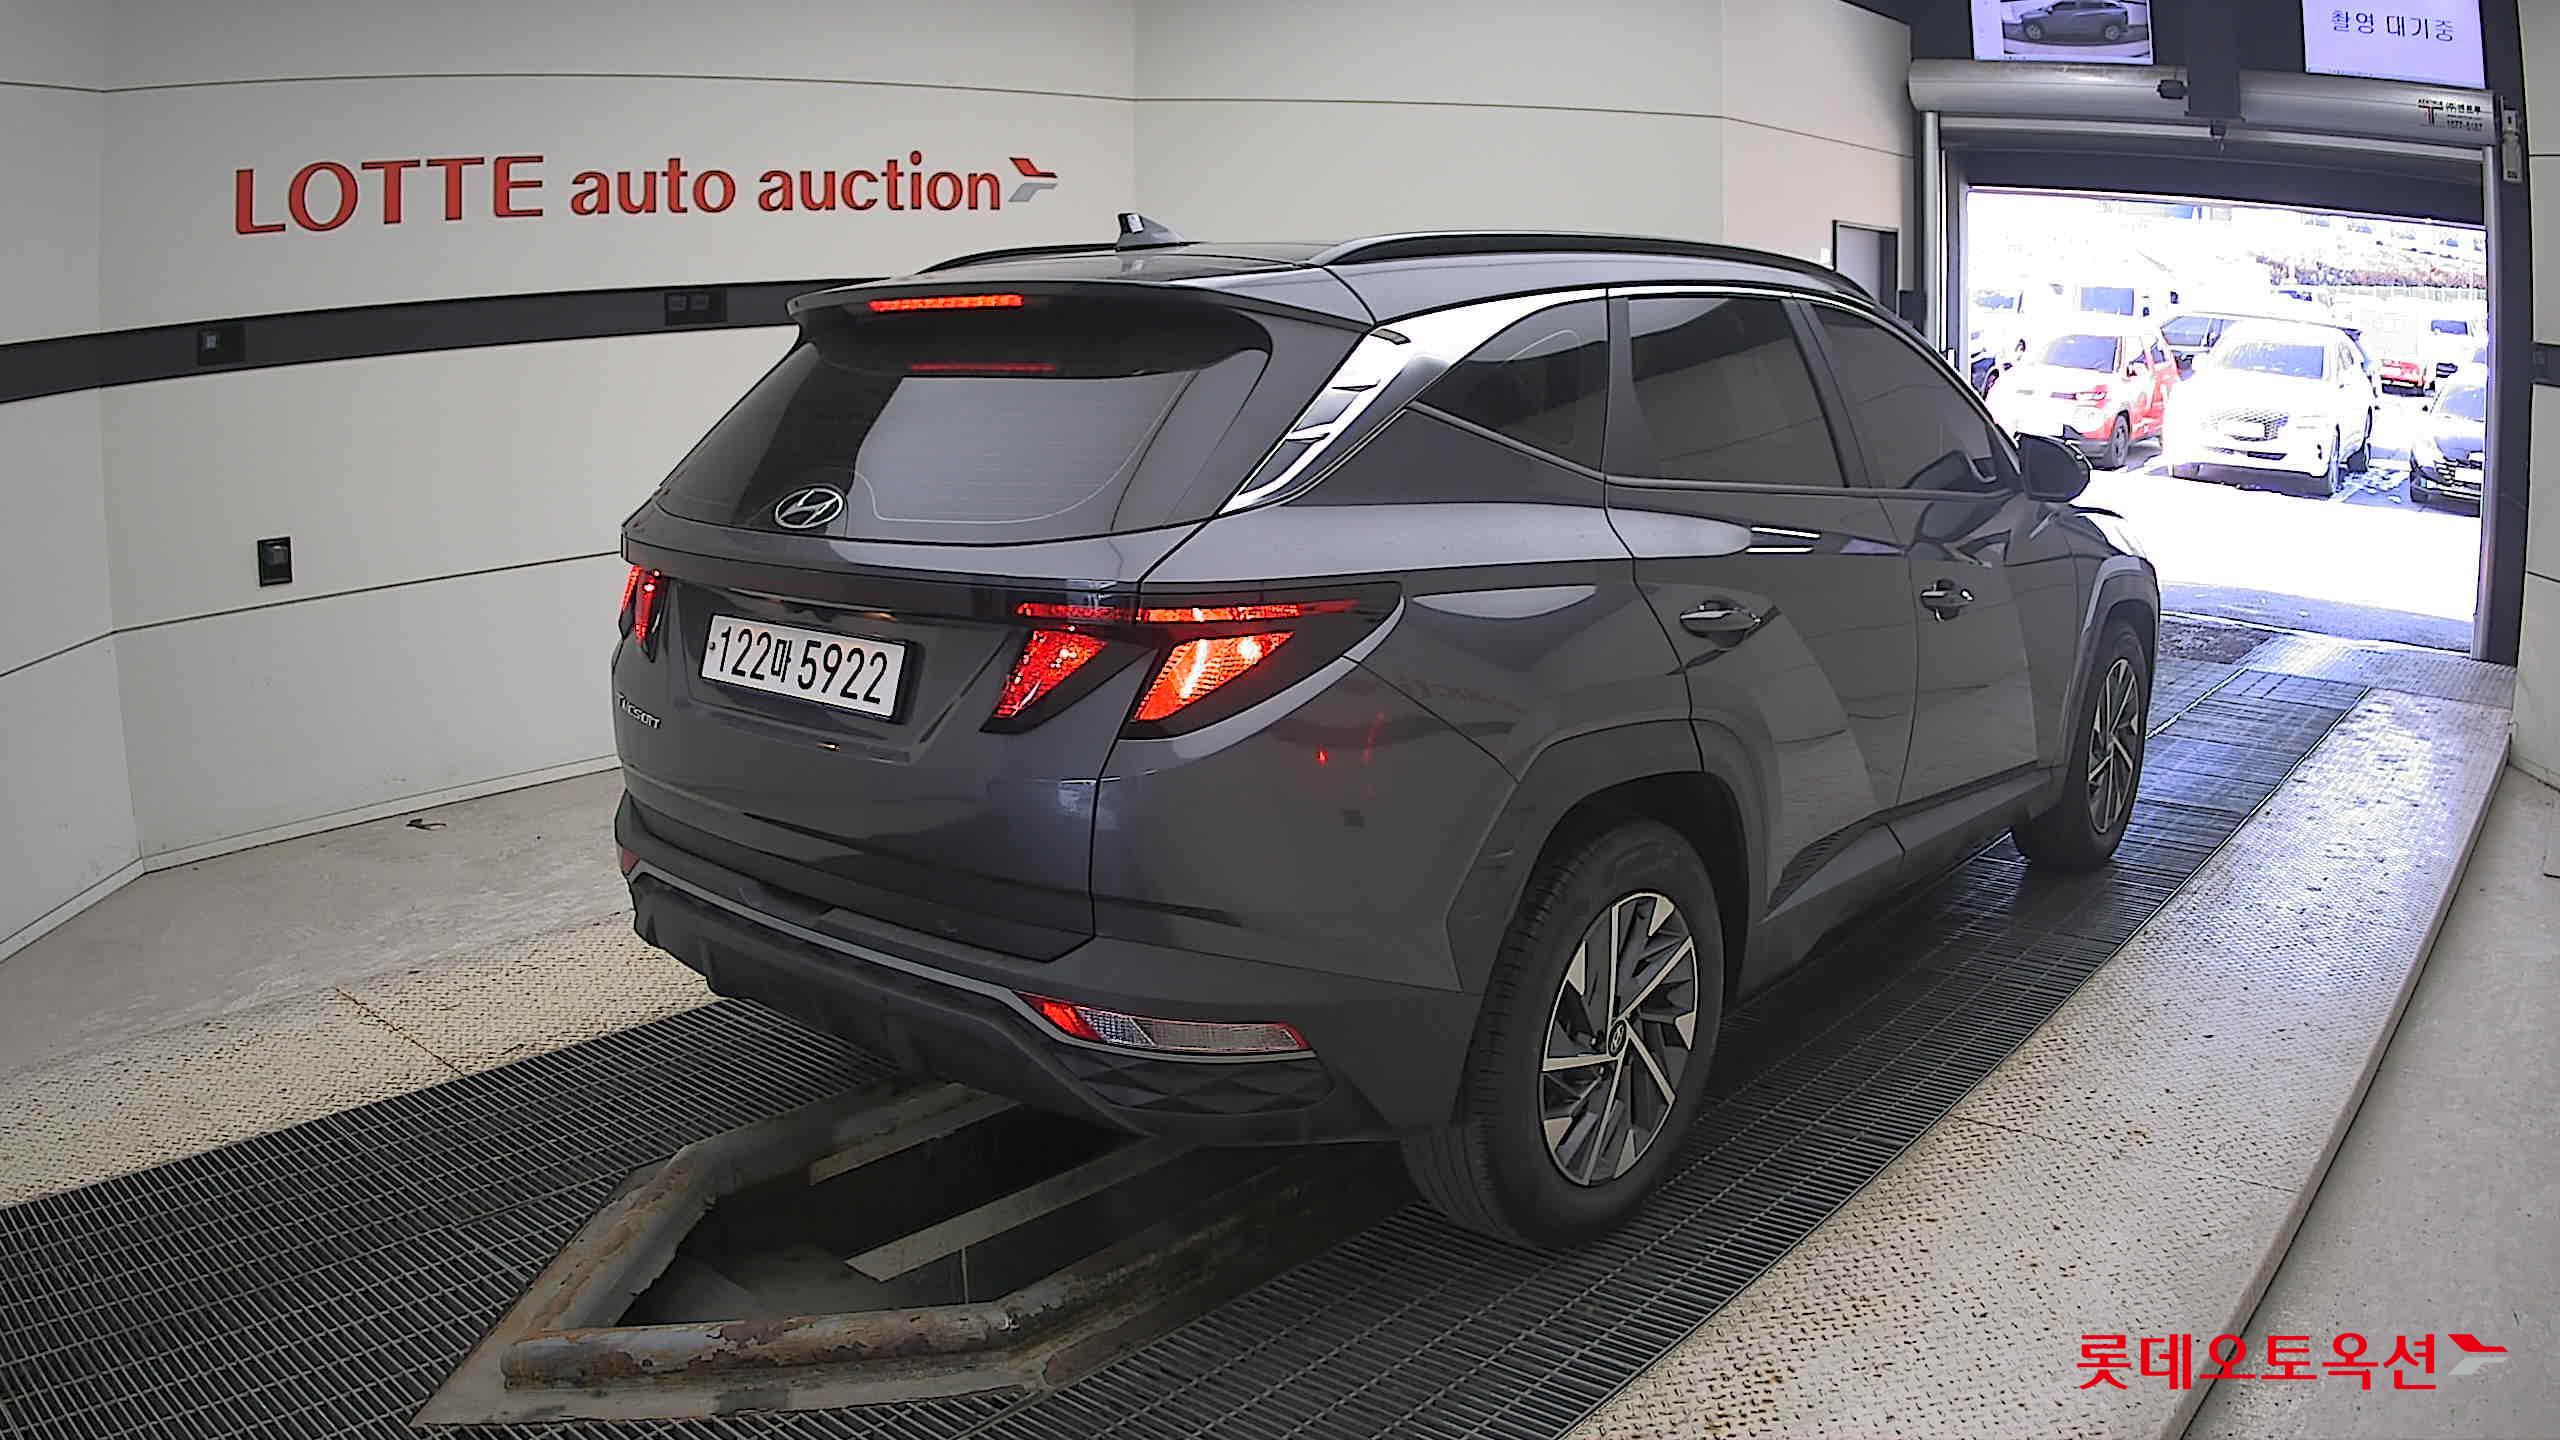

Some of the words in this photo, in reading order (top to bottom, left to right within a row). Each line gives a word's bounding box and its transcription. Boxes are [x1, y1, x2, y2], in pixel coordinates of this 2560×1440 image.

[2331, 10, 2374, 34] 촬영
[235, 155, 544, 235] LOTTE
[570, 157, 737, 216] auto
[757, 150, 1001, 211] auction
[719, 626, 793, 683] 122마
[797, 639, 888, 705] 5922
